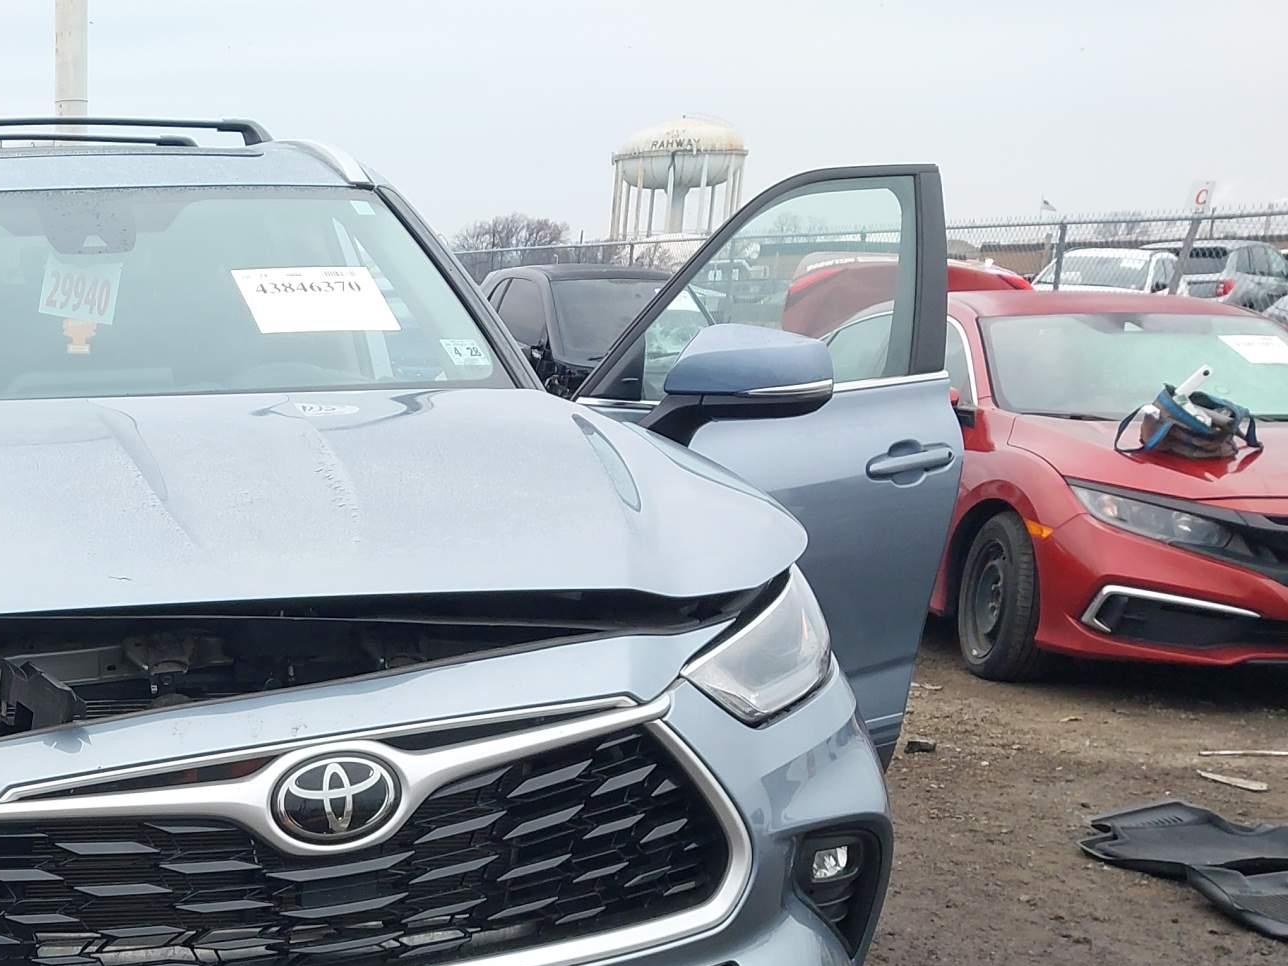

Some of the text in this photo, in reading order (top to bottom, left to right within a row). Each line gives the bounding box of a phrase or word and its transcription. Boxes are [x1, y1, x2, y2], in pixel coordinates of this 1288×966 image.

[650, 138, 701, 150] RAHWAY
[1195, 188, 1209, 206] C
[45, 270, 111, 316] 29940
[255, 280, 362, 295] 43846370
[453, 346, 463, 358] 4
